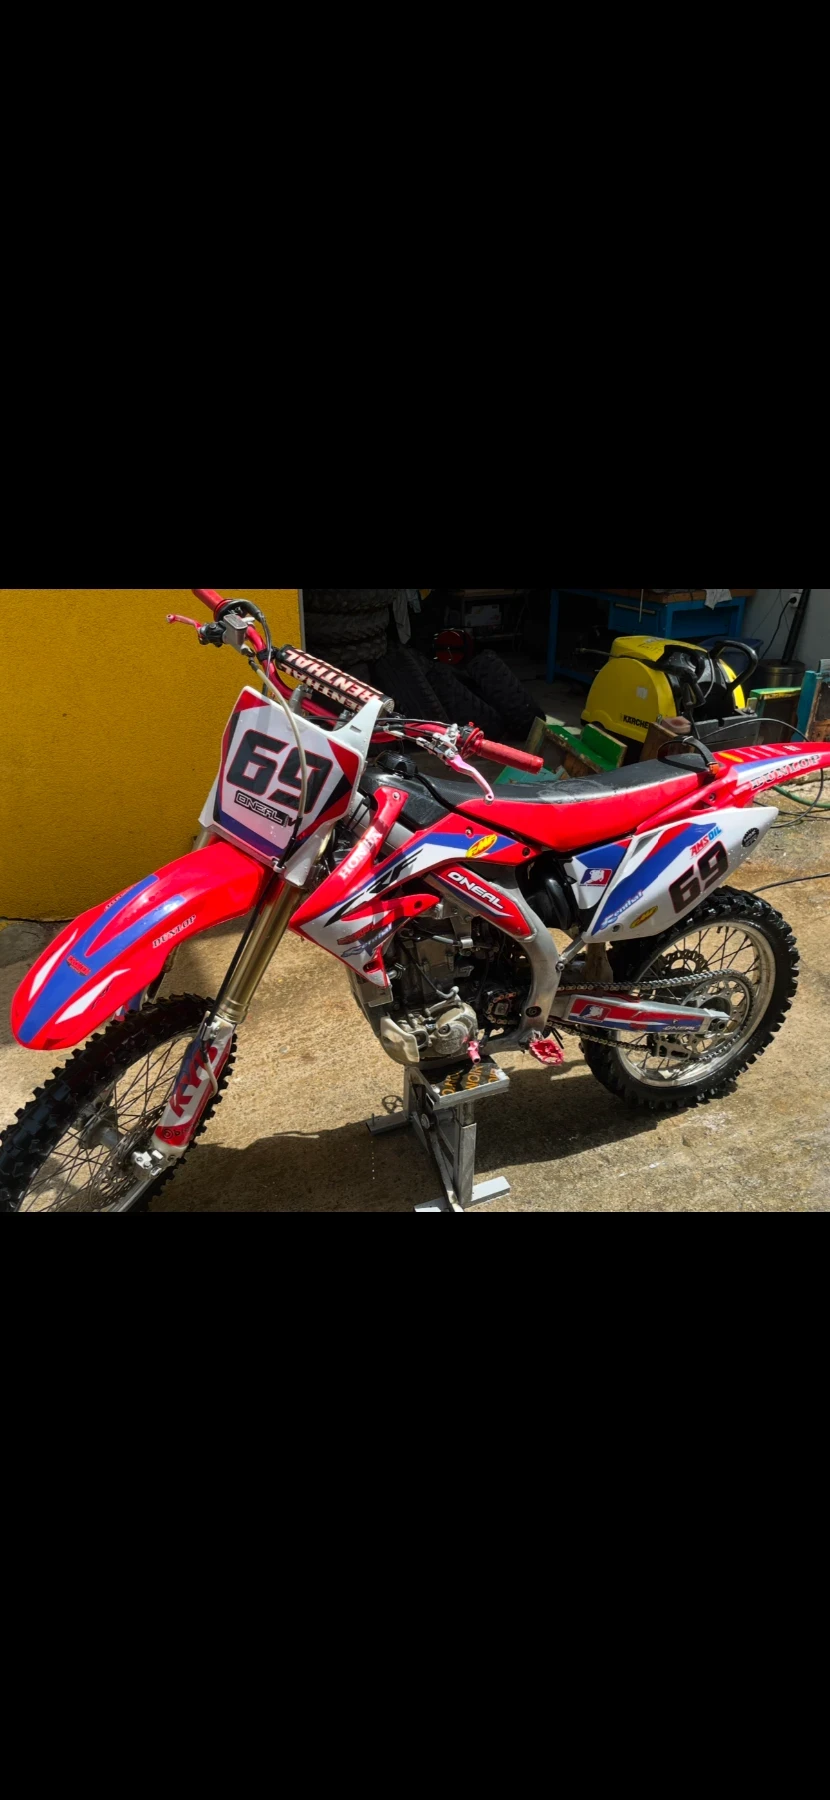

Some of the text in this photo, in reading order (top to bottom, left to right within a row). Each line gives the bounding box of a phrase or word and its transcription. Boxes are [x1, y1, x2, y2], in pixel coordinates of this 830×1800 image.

[226, 728, 334, 815] 69
[750, 754, 820, 789] DUNLOP
[338, 825, 383, 880] HONDA
[690, 825, 722, 858] AMSOIL
[447, 871, 504, 909] ONEAL
[668, 840, 729, 914] 69
[152, 914, 197, 949] DUNLOP
